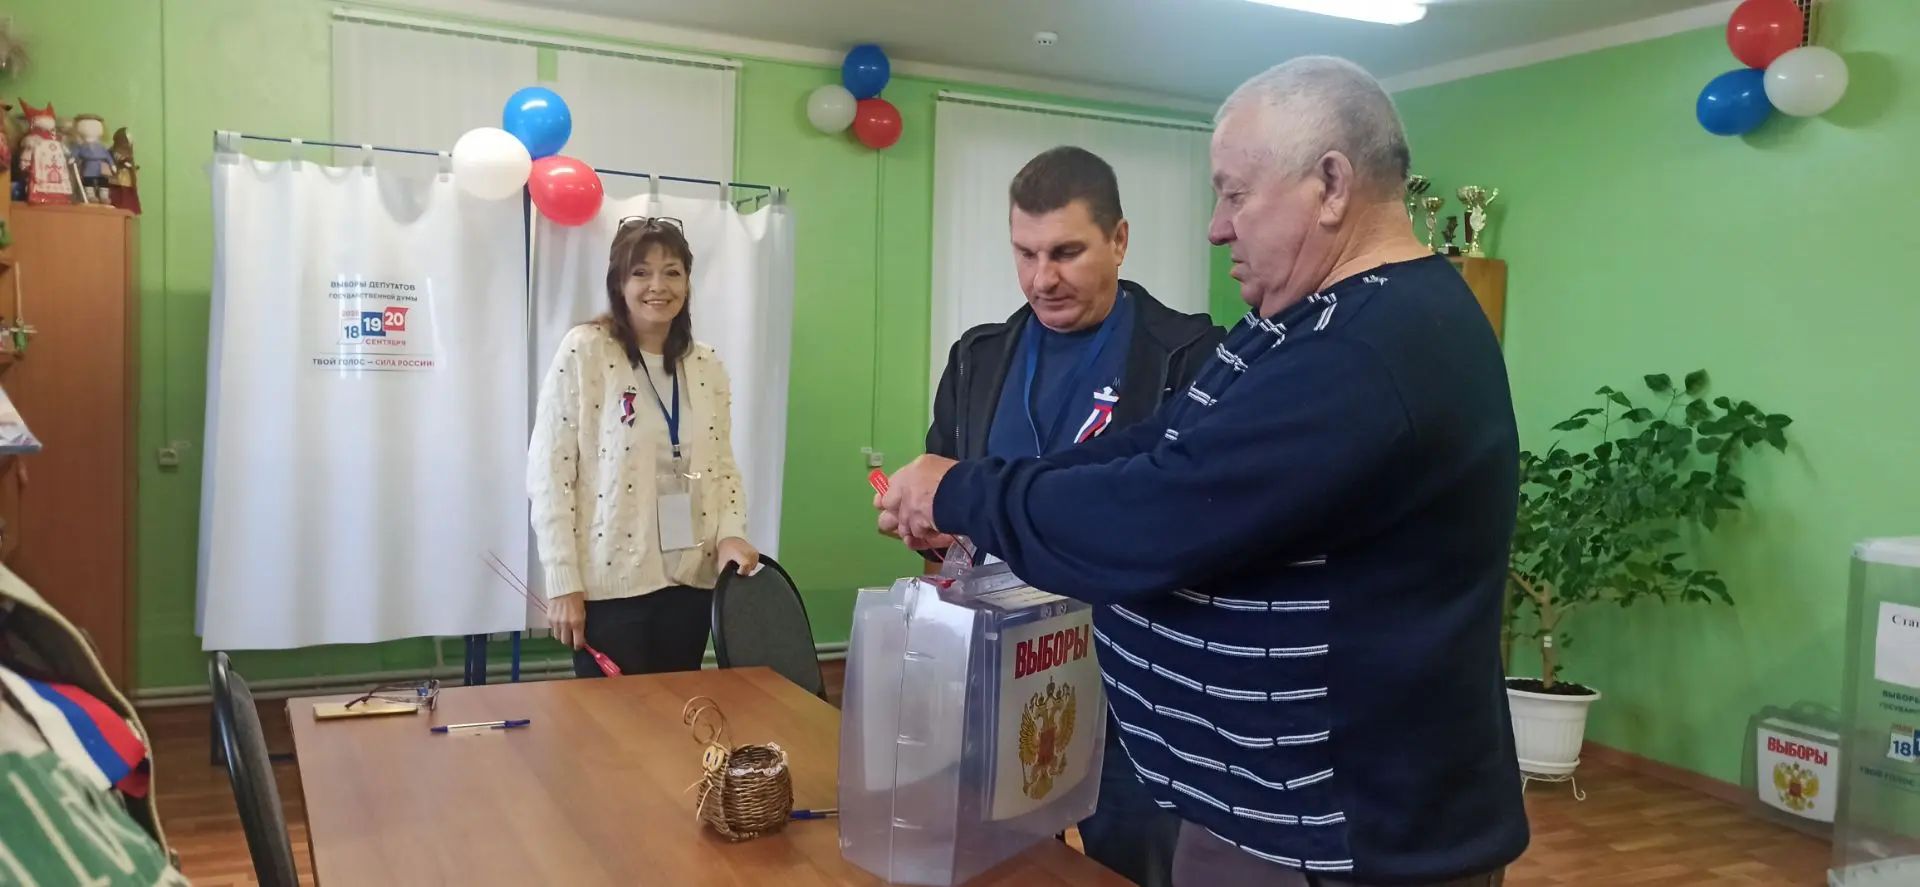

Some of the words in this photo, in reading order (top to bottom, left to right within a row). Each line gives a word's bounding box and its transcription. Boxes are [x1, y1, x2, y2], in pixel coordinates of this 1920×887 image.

[330, 281, 367, 289] ВЫБОРЫ
[368, 281, 416, 292] ДЕПУТАТОВ
[396, 294, 418, 302] ДУМЫ
[344, 325, 359, 339] 18
[363, 317, 381, 332] 19
[384, 311, 404, 326] 20
[312, 357, 336, 366] ТВОЙ
[338, 358, 365, 366] ГОЛОС
[1015, 624, 1090, 679] ВЫБОРЫ
[1768, 736, 1828, 766] ВЫБОРЫ
[1893, 740, 1911, 756] 18
